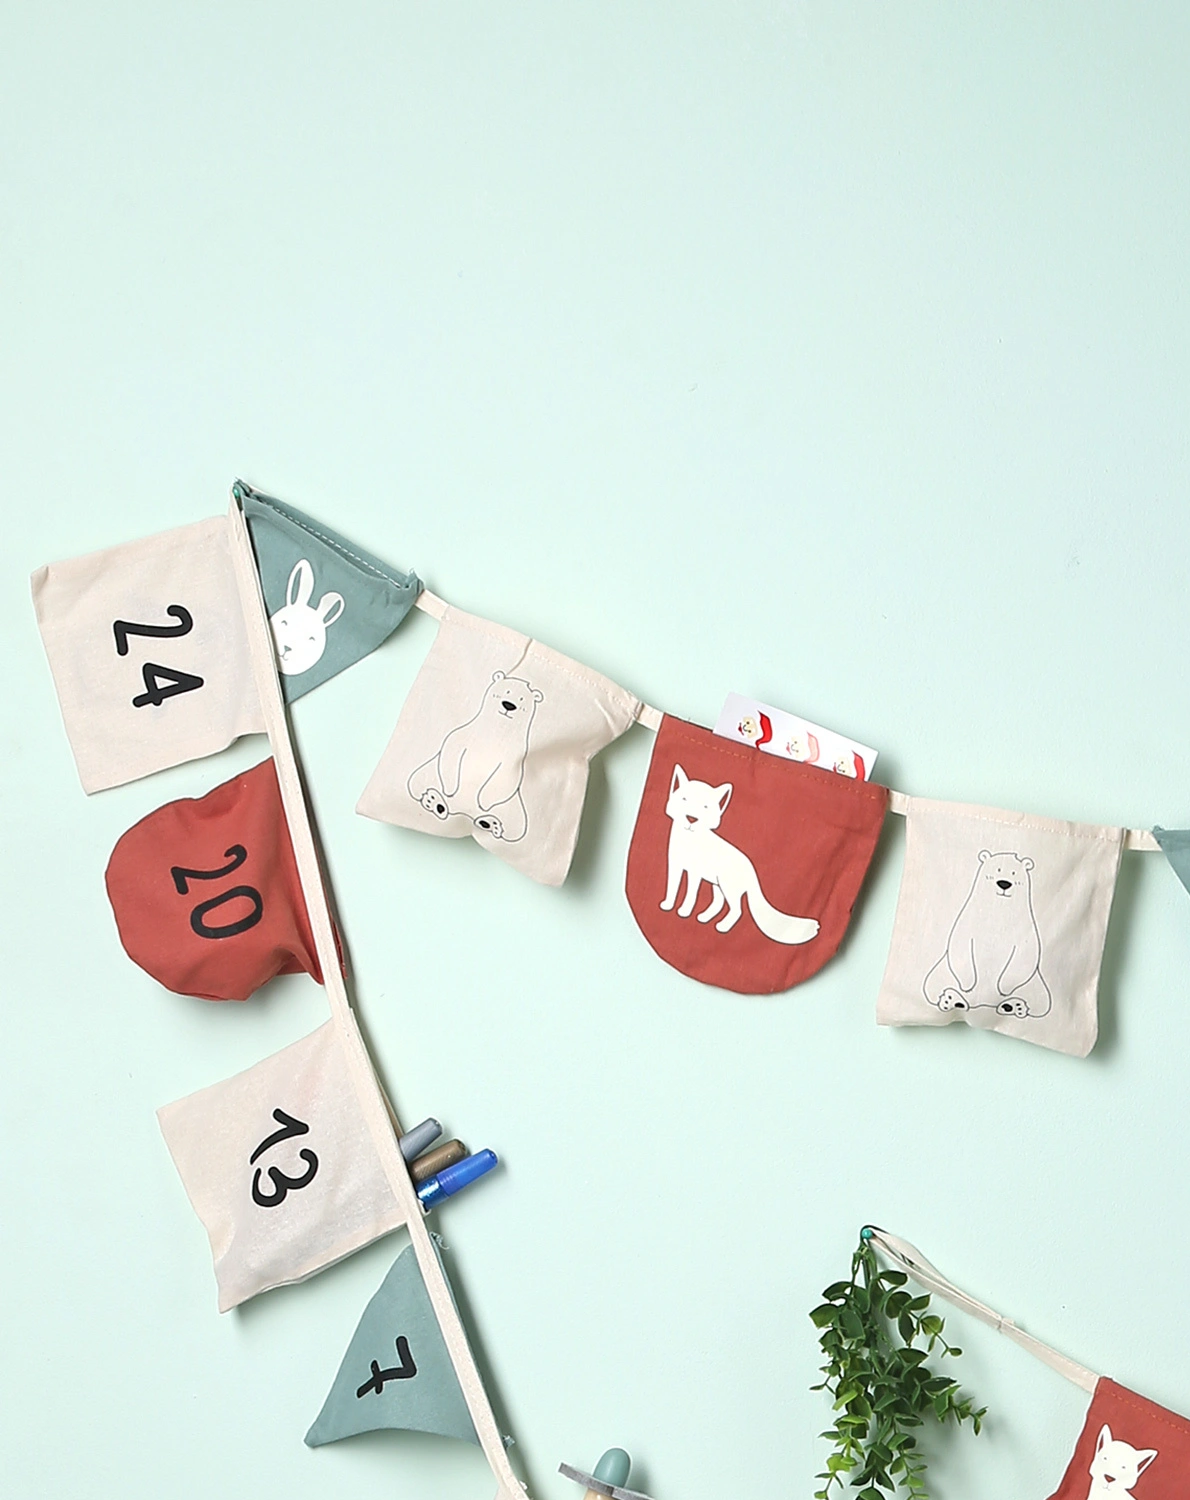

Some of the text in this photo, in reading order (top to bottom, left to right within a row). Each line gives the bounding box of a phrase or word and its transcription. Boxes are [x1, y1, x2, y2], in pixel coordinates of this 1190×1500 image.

[113, 604, 204, 708] 24
[171, 844, 263, 939] 20
[249, 1108, 319, 1208] 13
[356, 1335, 417, 1399] 7
